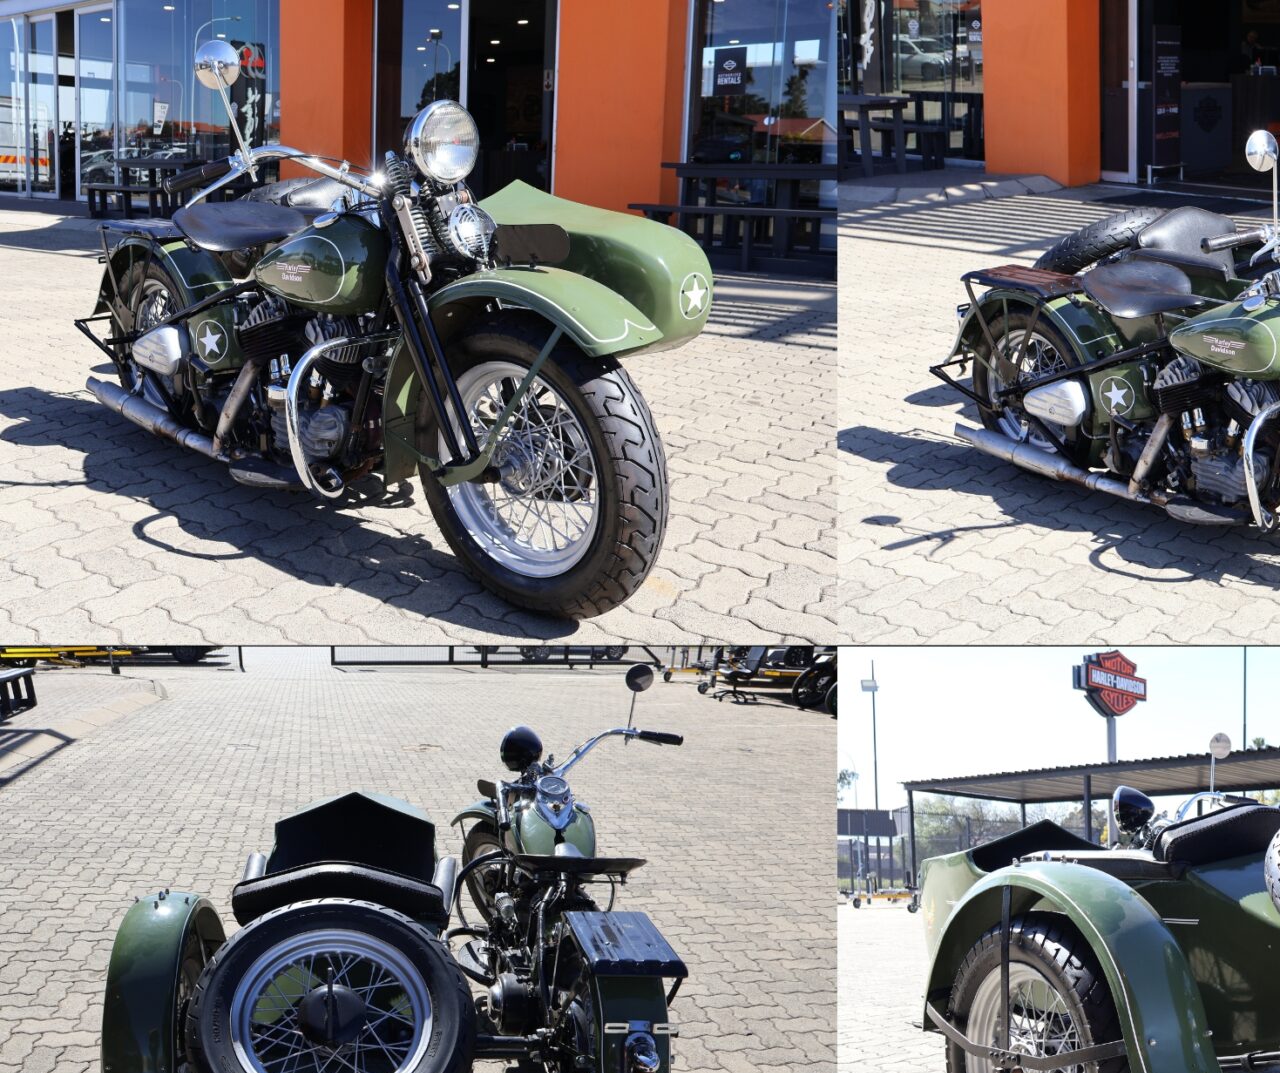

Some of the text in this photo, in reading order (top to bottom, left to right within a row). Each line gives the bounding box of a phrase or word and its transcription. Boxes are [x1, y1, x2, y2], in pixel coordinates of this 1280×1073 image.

[717, 77, 742, 85] RENTALS
[1210, 344, 1236, 356] Davidson
[1103, 658, 1134, 676] MOTOR
[1091, 668, 1145, 695] HARLEY-DAVIDSON
[1104, 690, 1134, 709] CYCLES
